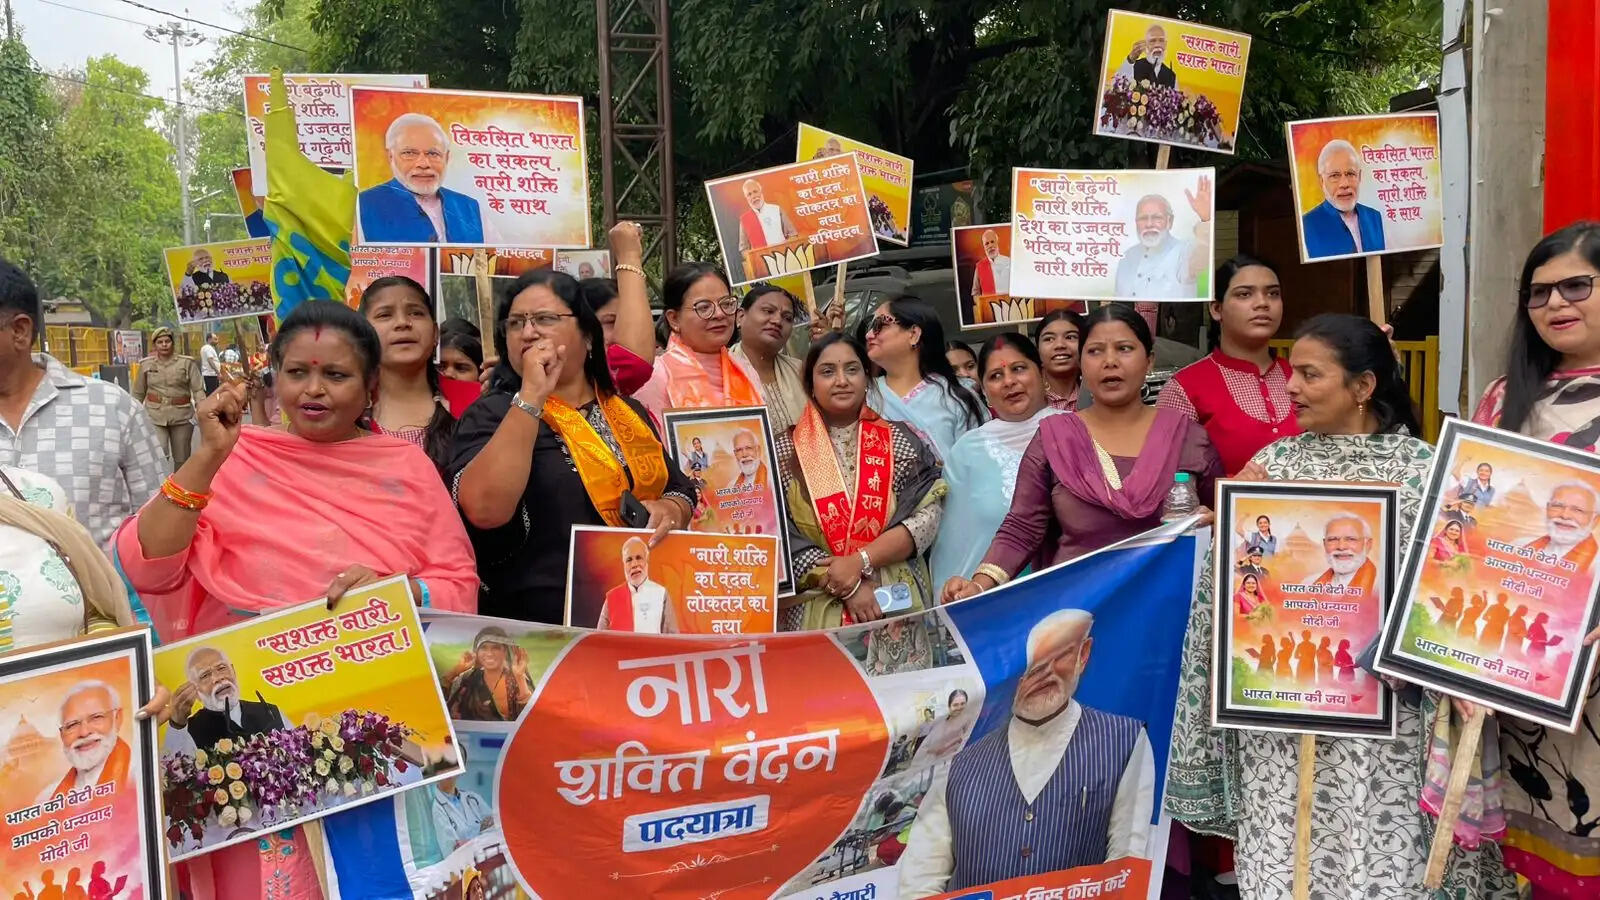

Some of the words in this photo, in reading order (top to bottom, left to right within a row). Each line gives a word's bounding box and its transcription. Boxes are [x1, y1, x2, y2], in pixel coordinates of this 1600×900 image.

[1177, 53, 1208, 69] सशक्त
[452, 124, 528, 147] विकसित
[529, 132, 577, 150] भारत
[468, 153, 496, 168] का
[1362, 144, 1409, 164] विकसित
[1410, 146, 1436, 160] भारत
[474, 171, 516, 191] नारी
[518, 172, 558, 193] शक्ति
[1373, 169, 1389, 182] का
[797, 188, 816, 199] का
[842, 195, 860, 205] का
[1378, 184, 1402, 202] नारी
[1404, 182, 1427, 200] शक्ति
[487, 193, 504, 213] के
[510, 199, 550, 215] साथ
[1034, 196, 1069, 215] नारी
[1385, 204, 1396, 221] के
[1399, 207, 1423, 220] साथ
[818, 214, 845, 226] नया
[1018, 215, 1047, 234] देश
[1048, 221, 1071, 235] का
[808, 225, 863, 243] अभिनंदन
[1024, 236, 1074, 255] भविष्य
[1076, 238, 1123, 258] गढ़ेगी
[1034, 257, 1069, 276] नारी
[1072, 257, 1108, 277] शक्ति
[865, 455, 885, 467] जय
[867, 470, 882, 492] श्री
[862, 494, 883, 512] राम
[733, 543, 768, 566] शक्ति
[1488, 539, 1514, 553] भारत
[1517, 547, 1533, 558] की
[1537, 551, 1557, 565] बेटी
[1560, 559, 1576, 571] का
[694, 572, 717, 588] का
[1485, 557, 1523, 574] आपको
[1527, 568, 1568, 587] धन्यवाद
[1282, 584, 1305, 593] भारत
[1308, 582, 1322, 593] की
[1326, 584, 1344, 594] बेटी
[1502, 578, 1525, 593] मोदी
[1529, 586, 1542, 597] जी
[686, 590, 747, 612] लोकतंत्र
[748, 596, 770, 612] का
[1284, 599, 1317, 609] आपको
[1321, 602, 1358, 611] धन्यवाद
[711, 620, 743, 635] नया
[1303, 616, 1324, 626] मोदी
[1326, 616, 1339, 627] जी
[262, 652, 334, 686] सशक्त
[1416, 638, 1448, 656] भारत
[1451, 649, 1480, 666] माता
[1483, 659, 1503, 673] की
[1507, 666, 1529, 680] जय
[1244, 689, 1272, 700] भारत
[1276, 691, 1301, 701] माता
[1305, 689, 1321, 703] की
[1326, 694, 1346, 704] जय
[554, 740, 711, 805] शक्ति
[722, 729, 840, 784] वंदन
[6, 805, 40, 824] भारत
[44, 794, 64, 812] की
[68, 785, 92, 804] बेटी
[95, 782, 114, 796] का
[13, 821, 59, 848] आपको
[64, 806, 112, 830] धन्यवाद
[639, 804, 756, 843] पदयात्रा
[40, 841, 69, 862] मोदी
[73, 834, 88, 849] जी
[1067, 878, 1103, 899] कॉल
[1105, 869, 1132, 892] करें
